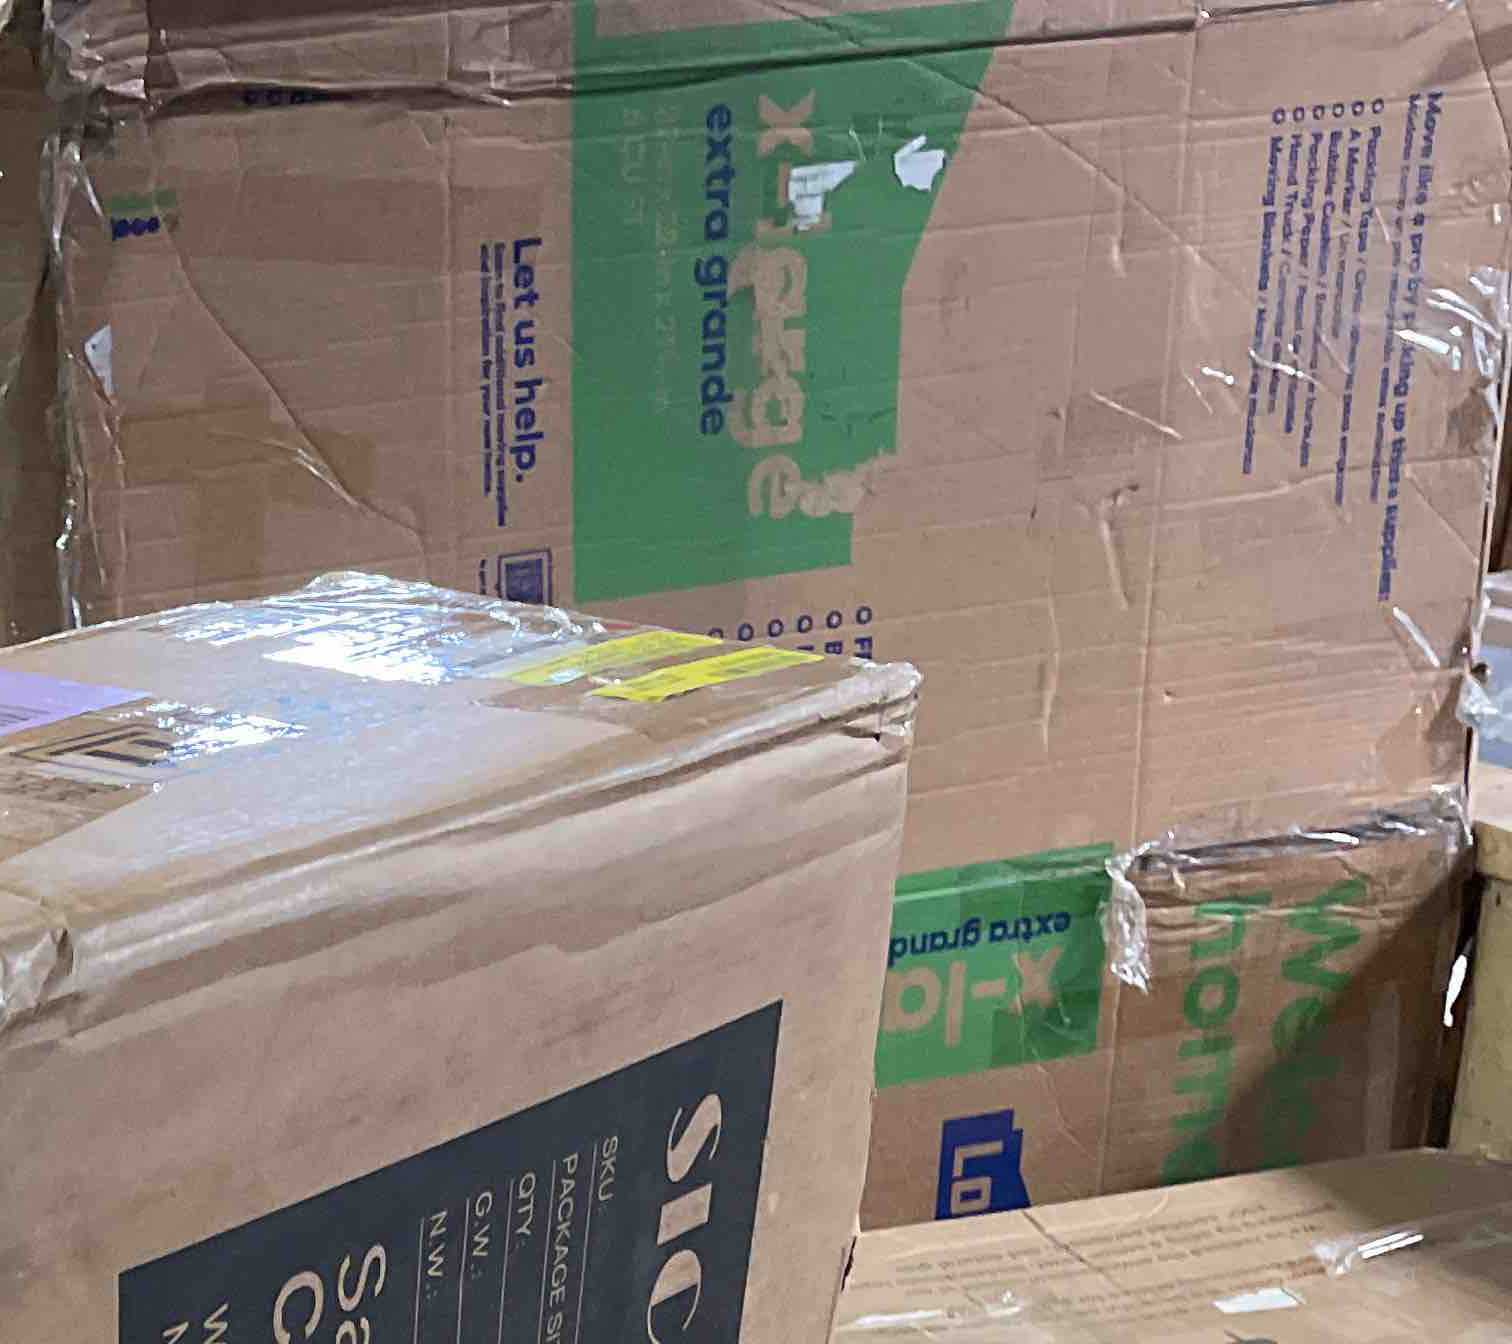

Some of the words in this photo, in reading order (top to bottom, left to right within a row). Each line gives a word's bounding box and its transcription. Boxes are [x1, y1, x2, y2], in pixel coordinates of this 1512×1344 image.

[703, 103, 736, 241] extra
[513, 237, 542, 309] Let
[513, 320, 535, 369] us
[694, 255, 734, 436] grande
[510, 378, 544, 483] help.
[989, 911, 1072, 944] extra
[514, 1171, 537, 1249] QTY:
[548, 1151, 579, 1308] PACKAGE
